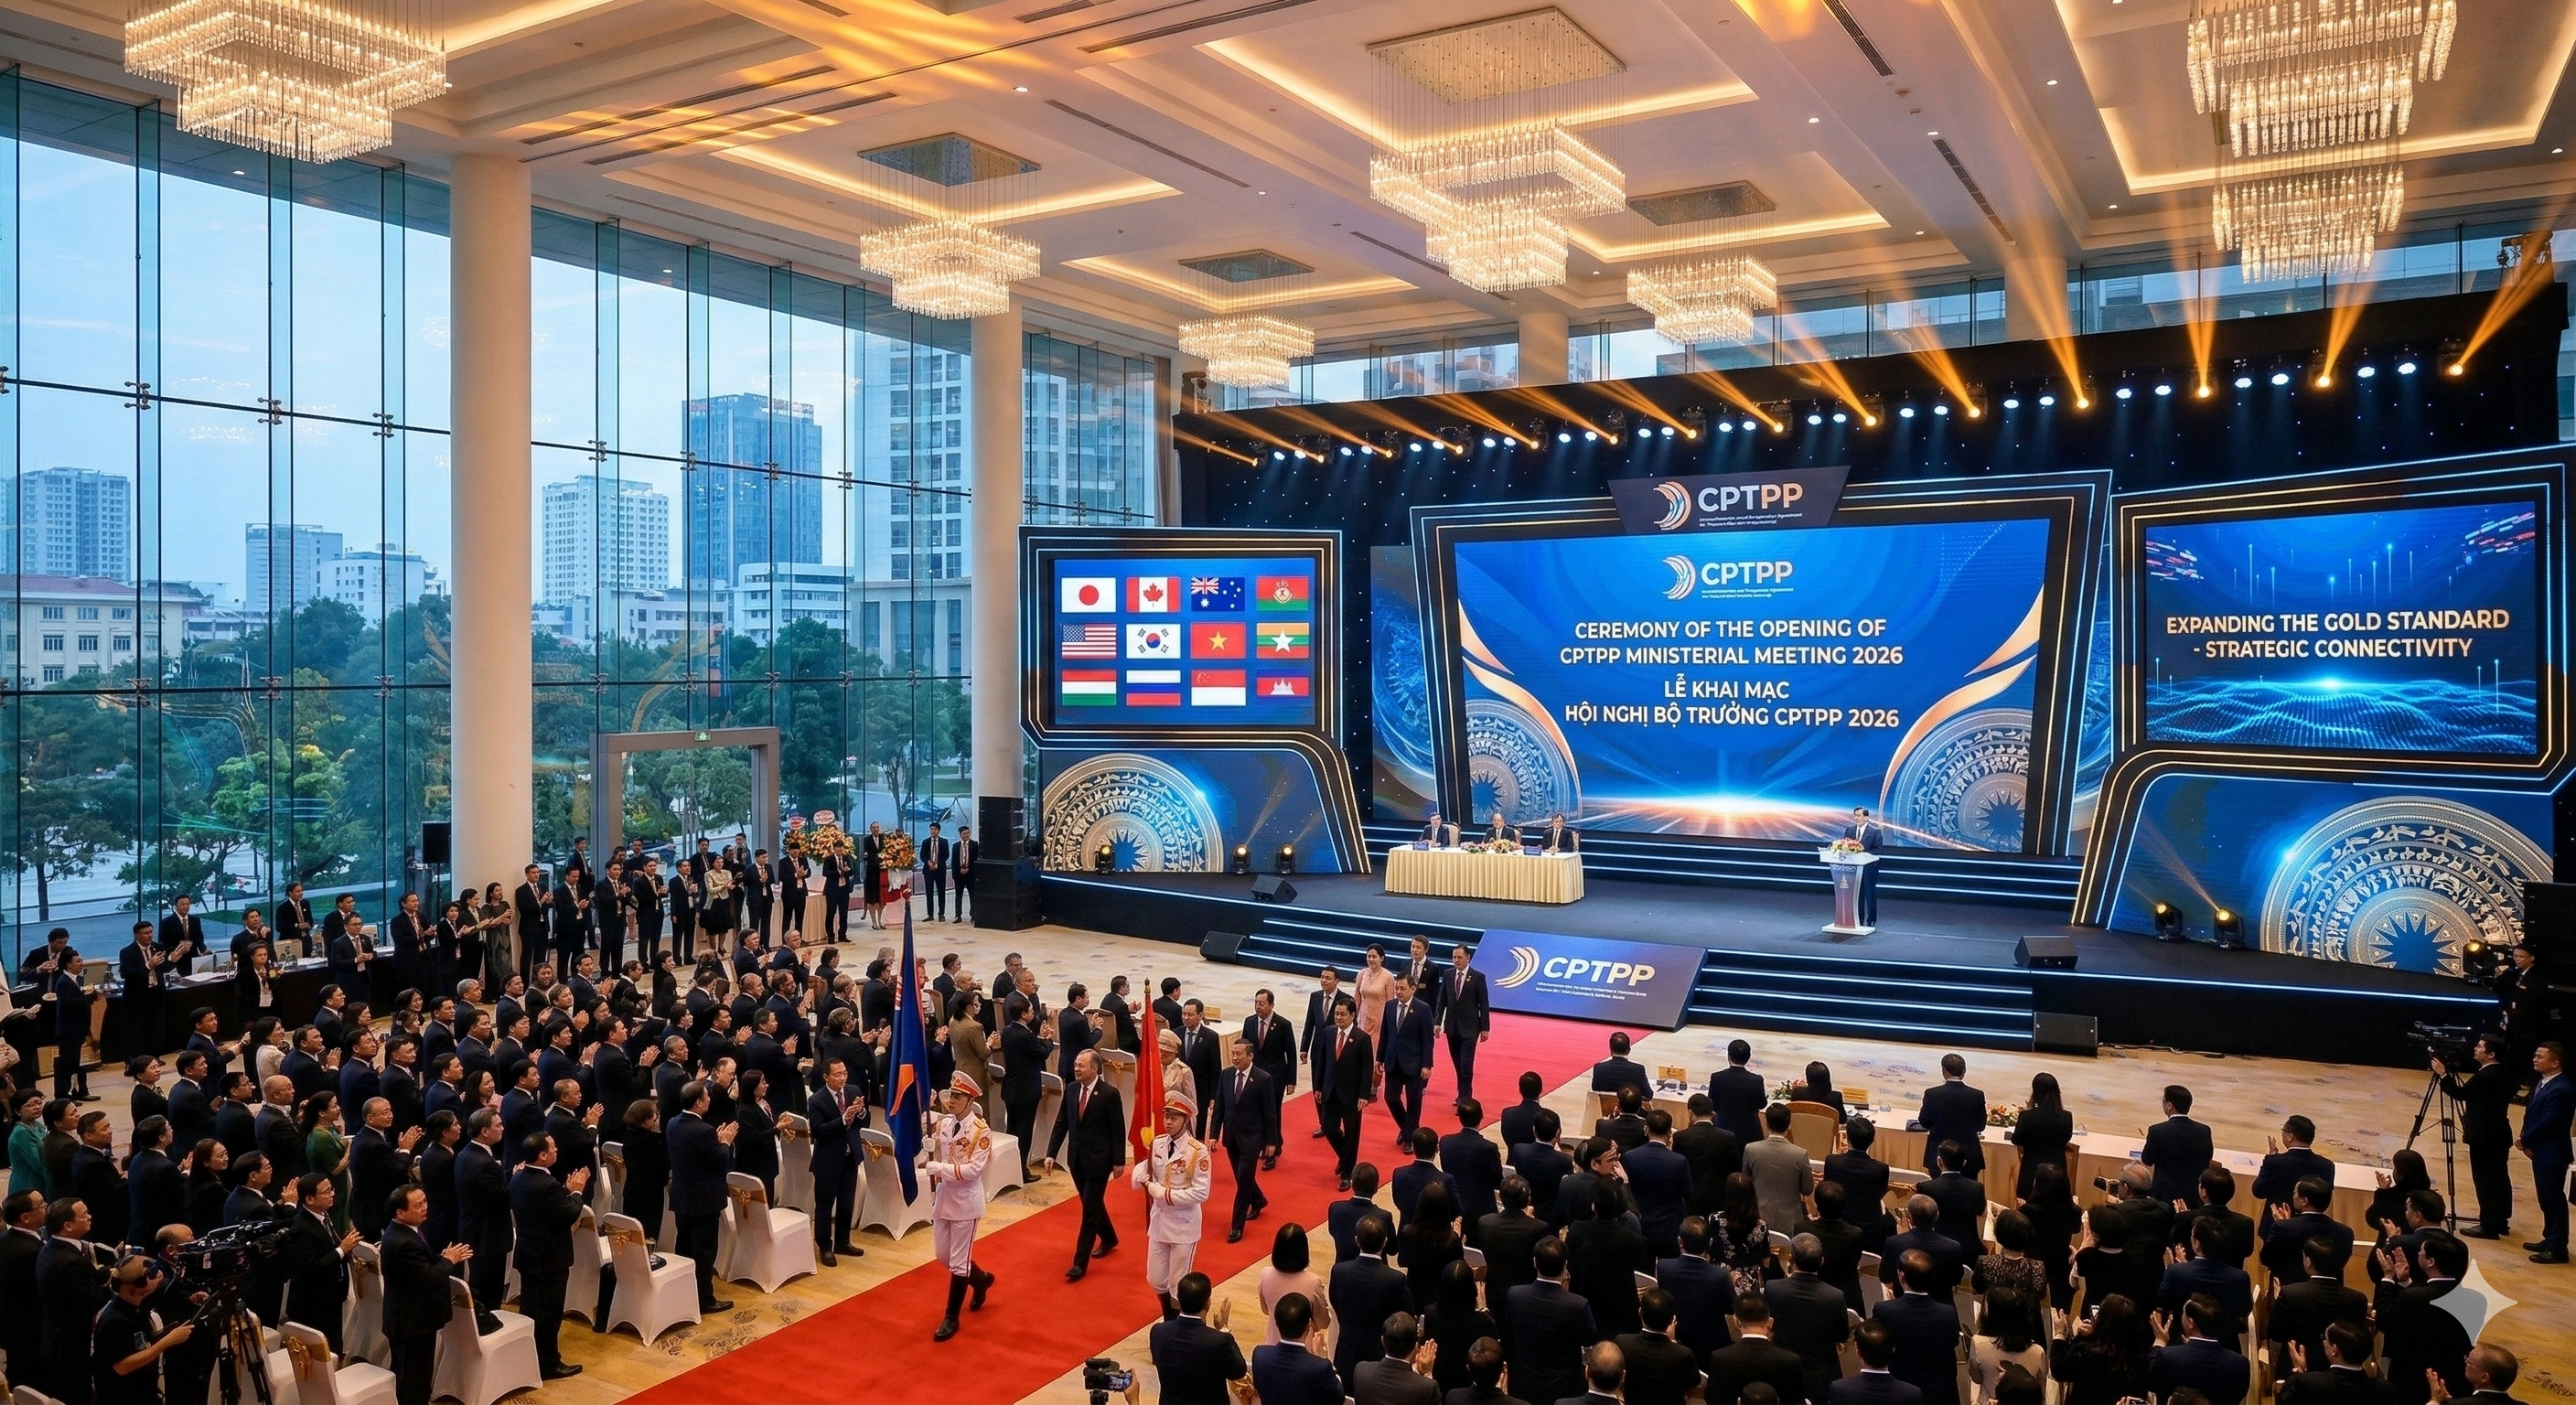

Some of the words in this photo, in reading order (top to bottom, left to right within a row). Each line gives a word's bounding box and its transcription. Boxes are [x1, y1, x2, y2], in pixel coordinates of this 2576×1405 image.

[1698, 482, 1803, 512] CPTPP
[1701, 561, 1793, 585] CPTPP
[1574, 621, 1680, 639] CEREMONY
[1684, 620, 1712, 638] OF
[1715, 620, 1755, 638] THE
[1759, 618, 1852, 638] OPENING
[1857, 618, 1887, 637] OF
[2166, 614, 2275, 634] EXPANDING
[2279, 613, 2319, 632] THE
[2324, 612, 2382, 632] GOLD
[2387, 609, 2510, 630] STANDARD
[1560, 647, 1621, 664] CPTPP
[1626, 647, 1750, 664] MINISTERIAL
[1755, 646, 1847, 665] MEETING
[1852, 646, 1904, 665] 2026
[2206, 639, 2310, 659] STRATEGIC
[2314, 638, 2473, 658] CONNECTIVITY
[1664, 672, 1687, 698] LỄ
[1692, 681, 1739, 698] KHAI
[1744, 681, 1790, 703] MẠC
[1565, 701, 1597, 726] HỘI
[1603, 705, 1648, 727] NGHỊ
[1654, 701, 1681, 728] BỘ
[1685, 701, 1768, 725] TRƯỞNG
[1774, 707, 1843, 726] CPTPP
[1848, 708, 1900, 728] 2026
[1543, 957, 1656, 987] CPTPP
